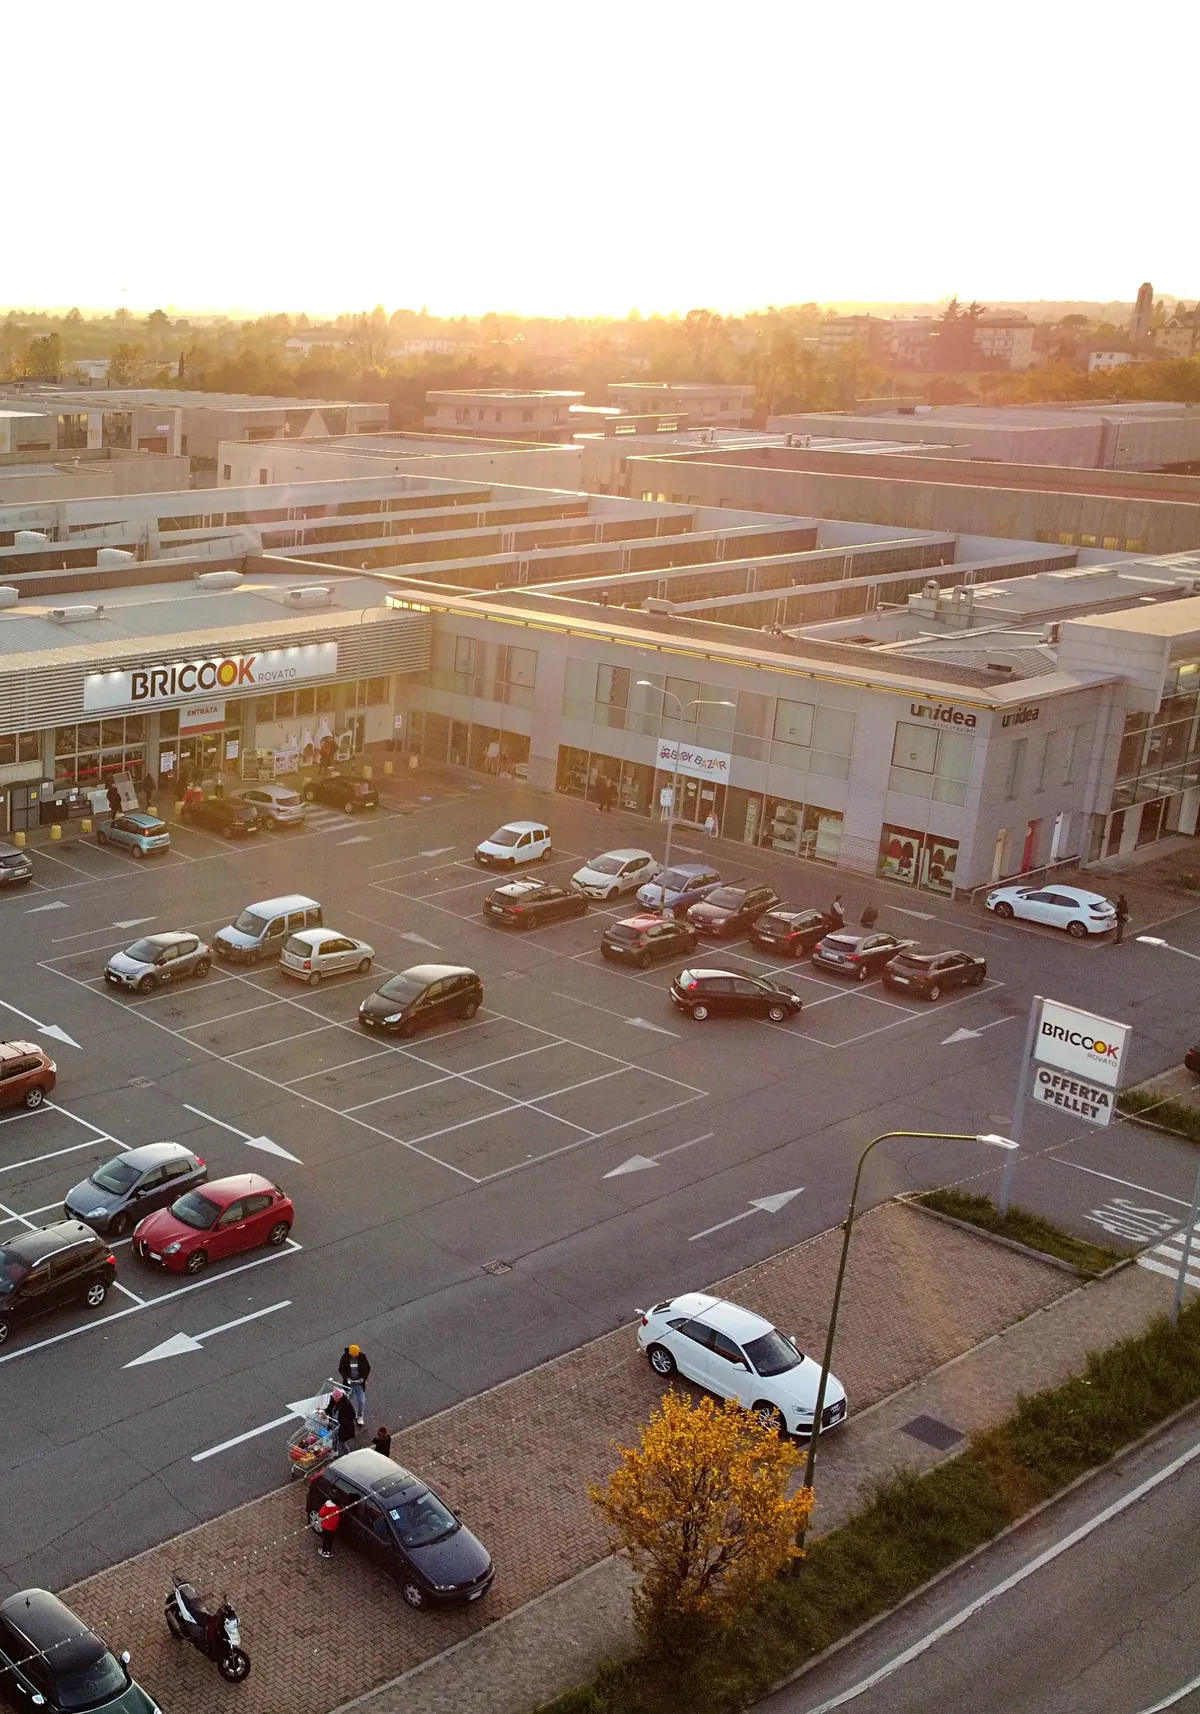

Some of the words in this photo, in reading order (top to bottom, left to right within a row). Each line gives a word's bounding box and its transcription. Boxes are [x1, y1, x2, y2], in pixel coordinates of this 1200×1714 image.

[132, 657, 256, 700] BRICOOK
[258, 668, 296, 682] ROVATO
[187, 706, 218, 717] ENTRATA
[911, 703, 977, 727] unidea
[1041, 1021, 1119, 1060] BRICOOK
[1087, 1052, 1118, 1068] ROVATO
[1038, 1071, 1109, 1108] OFFERTA
[1043, 1088, 1100, 1119] PELLET
